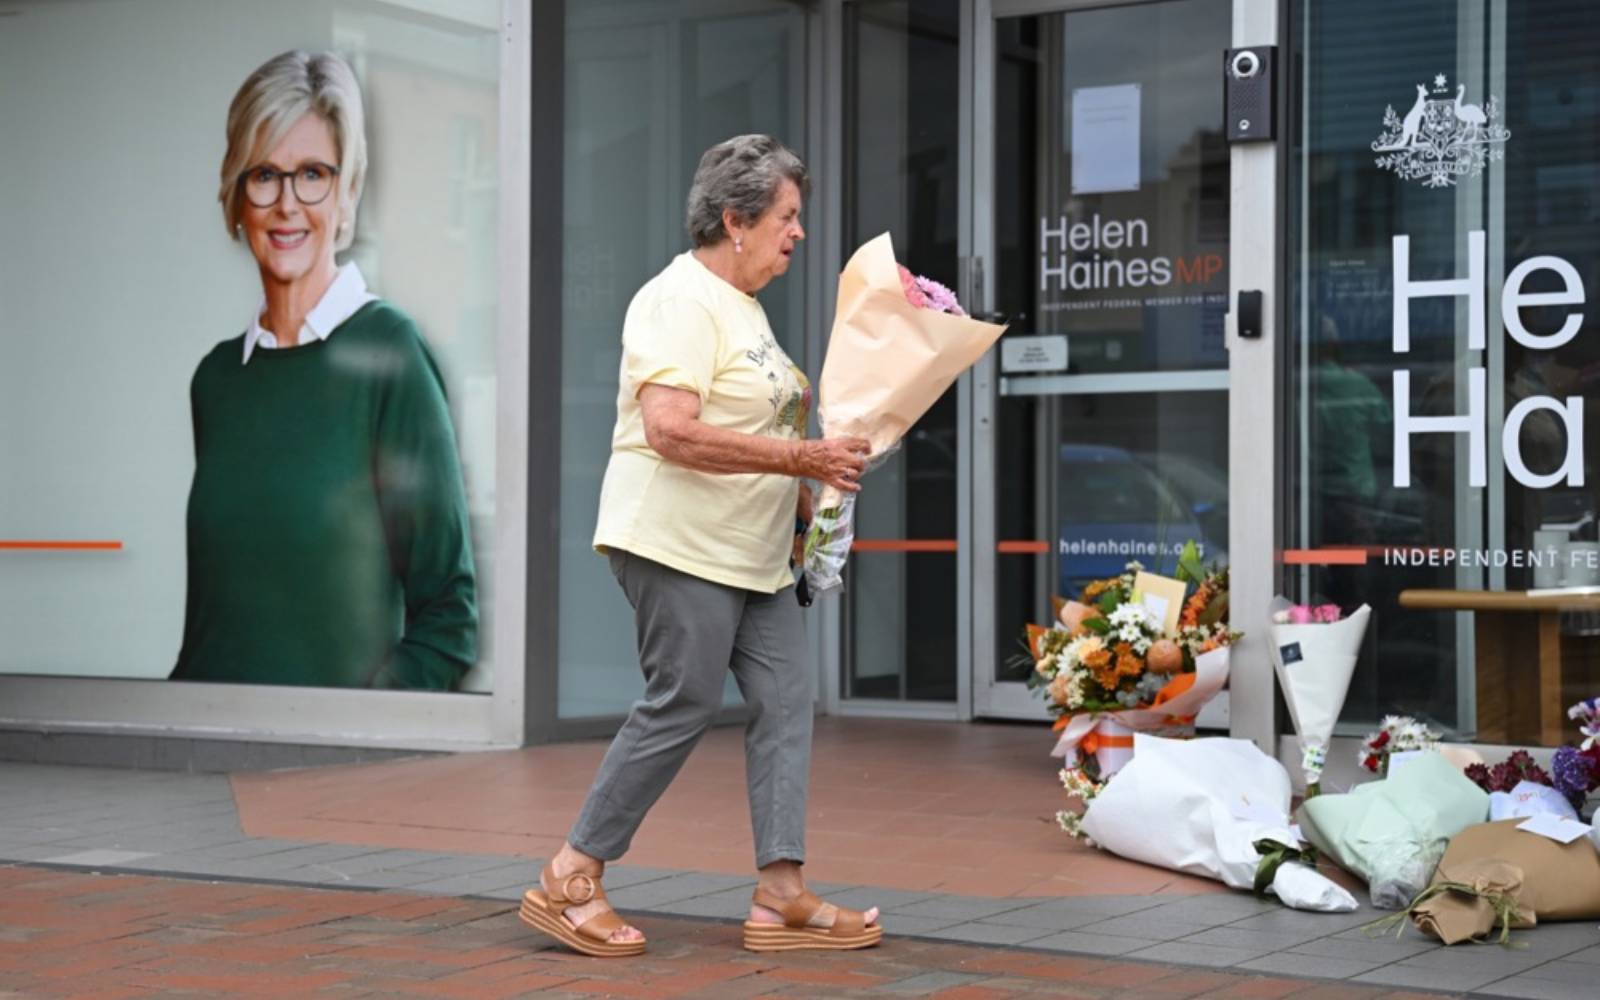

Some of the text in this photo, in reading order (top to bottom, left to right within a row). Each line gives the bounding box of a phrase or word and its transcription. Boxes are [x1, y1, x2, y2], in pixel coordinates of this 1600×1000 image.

[1040, 213, 1148, 252] Helen
[1040, 253, 1222, 291] Haines MP
[1039, 302, 1100, 312] INDEPENDENT
[1103, 299, 1143, 309] FEDERAL
[1145, 297, 1182, 307] MEMBER
[1392, 230, 1586, 353] He
[1392, 367, 1585, 489] Ha
[1384, 548, 1599, 569] INDEPENDENT FE
